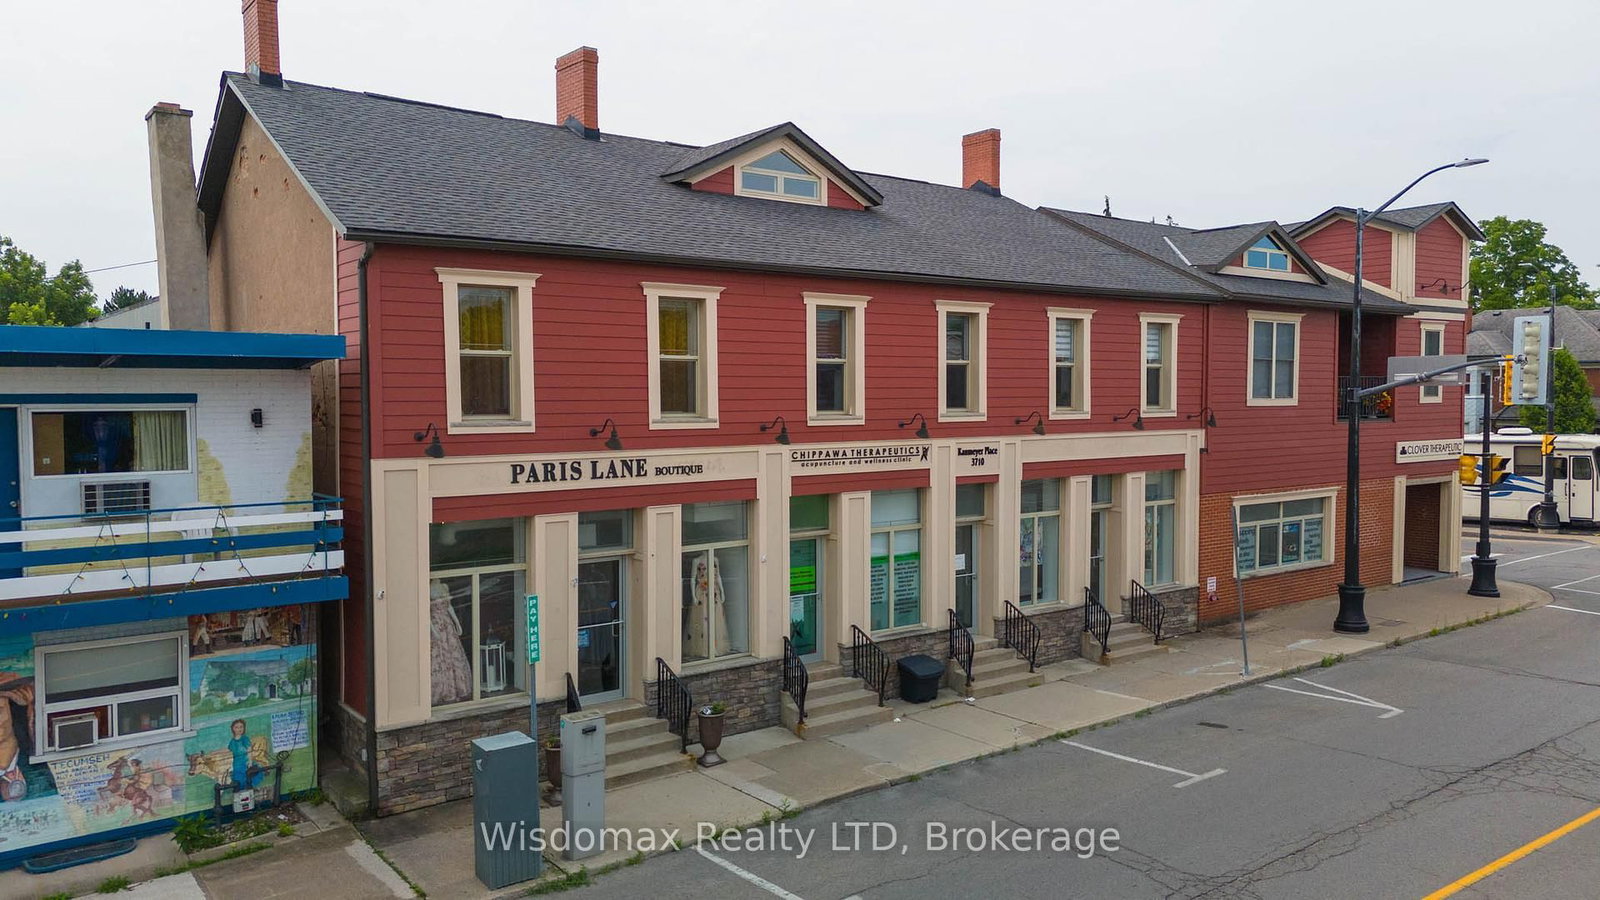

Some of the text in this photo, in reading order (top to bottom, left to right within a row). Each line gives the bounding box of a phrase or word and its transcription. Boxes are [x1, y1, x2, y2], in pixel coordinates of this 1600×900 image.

[791, 446, 920, 460] CHIPPAWA THERAPEUTICS
[984, 446, 998, 455] Place
[1407, 444, 1430, 455] CLOVER
[801, 460, 846, 468] acupuncture
[971, 457, 985, 466] 3710
[510, 458, 704, 484] PARIS LANE BOUTIQUE
[529, 599, 538, 658] PAY HERE
[50, 753, 110, 769] TECUMSEH
